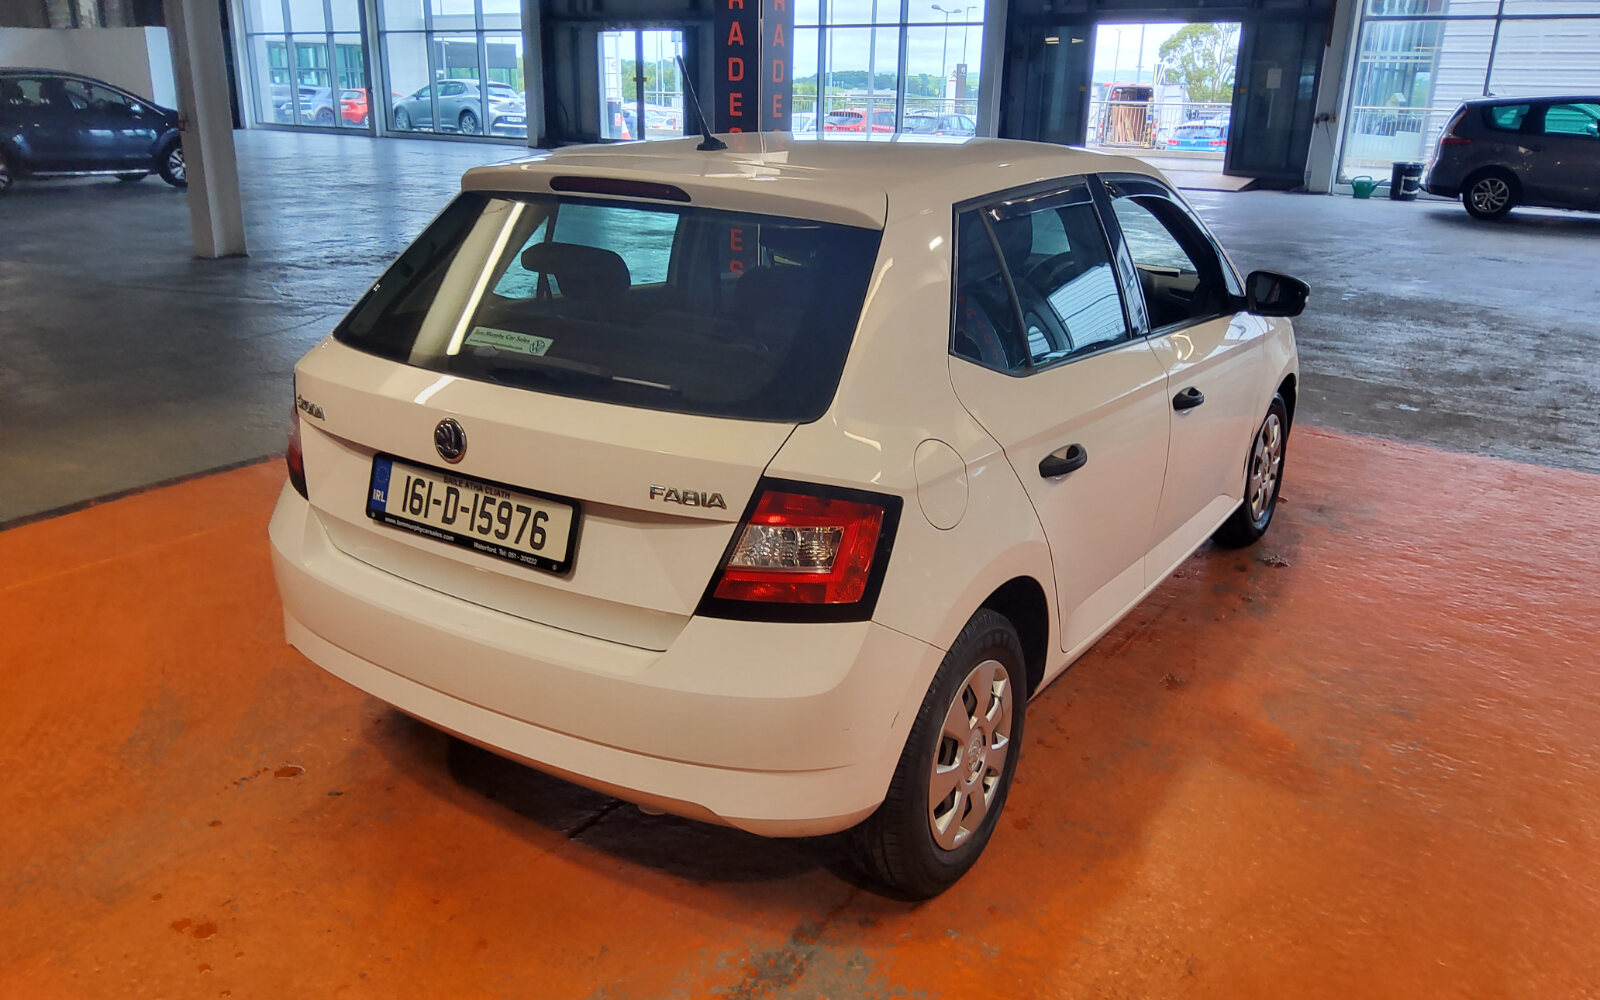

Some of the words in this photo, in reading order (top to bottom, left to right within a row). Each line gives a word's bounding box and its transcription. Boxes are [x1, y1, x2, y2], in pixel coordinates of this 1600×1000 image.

[372, 489, 386, 503] IRL
[484, 486, 511, 500] CLIATH
[649, 484, 728, 510] FABIA
[401, 475, 549, 551] 161-D-15976
